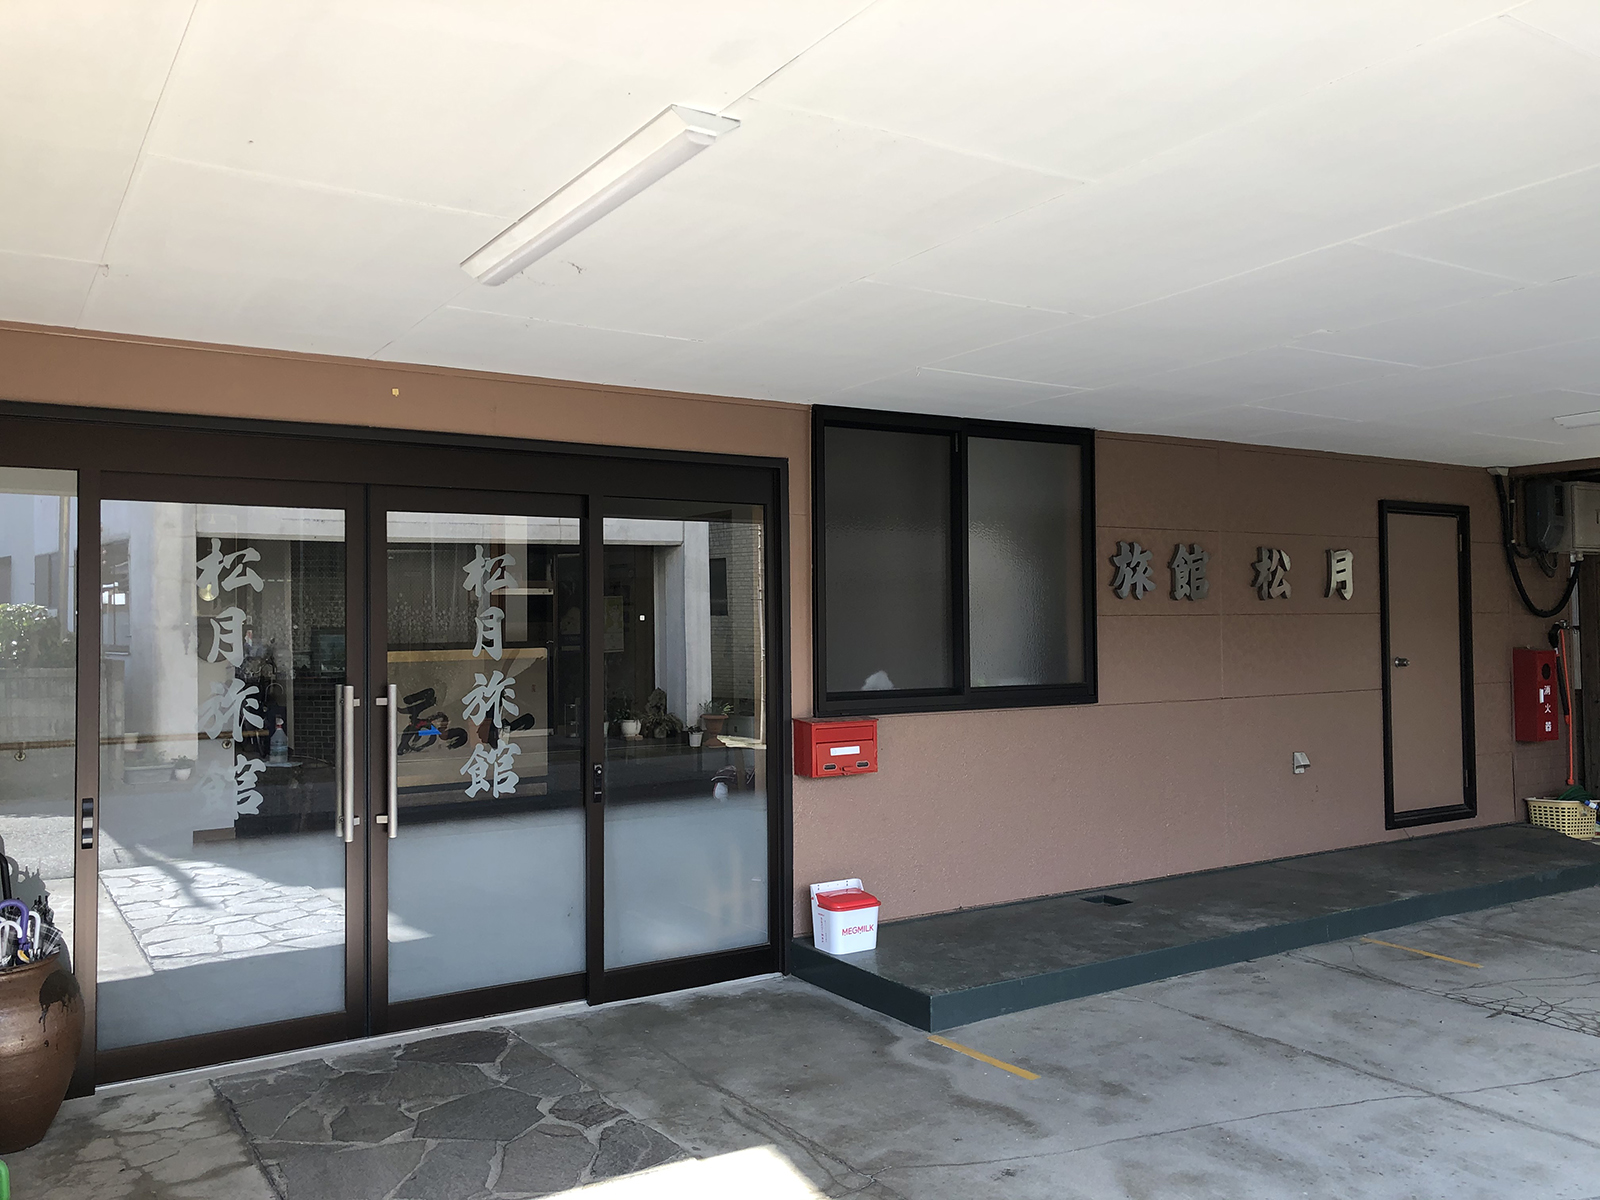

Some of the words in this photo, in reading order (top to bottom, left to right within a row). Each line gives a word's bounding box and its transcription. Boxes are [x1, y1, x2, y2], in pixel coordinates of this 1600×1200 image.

[1109, 541, 1210, 600] 旅館
[195, 538, 266, 820] 松月旅館
[460, 544, 522, 799] 松月旅館
[842, 924, 874, 936] MEGMILK
